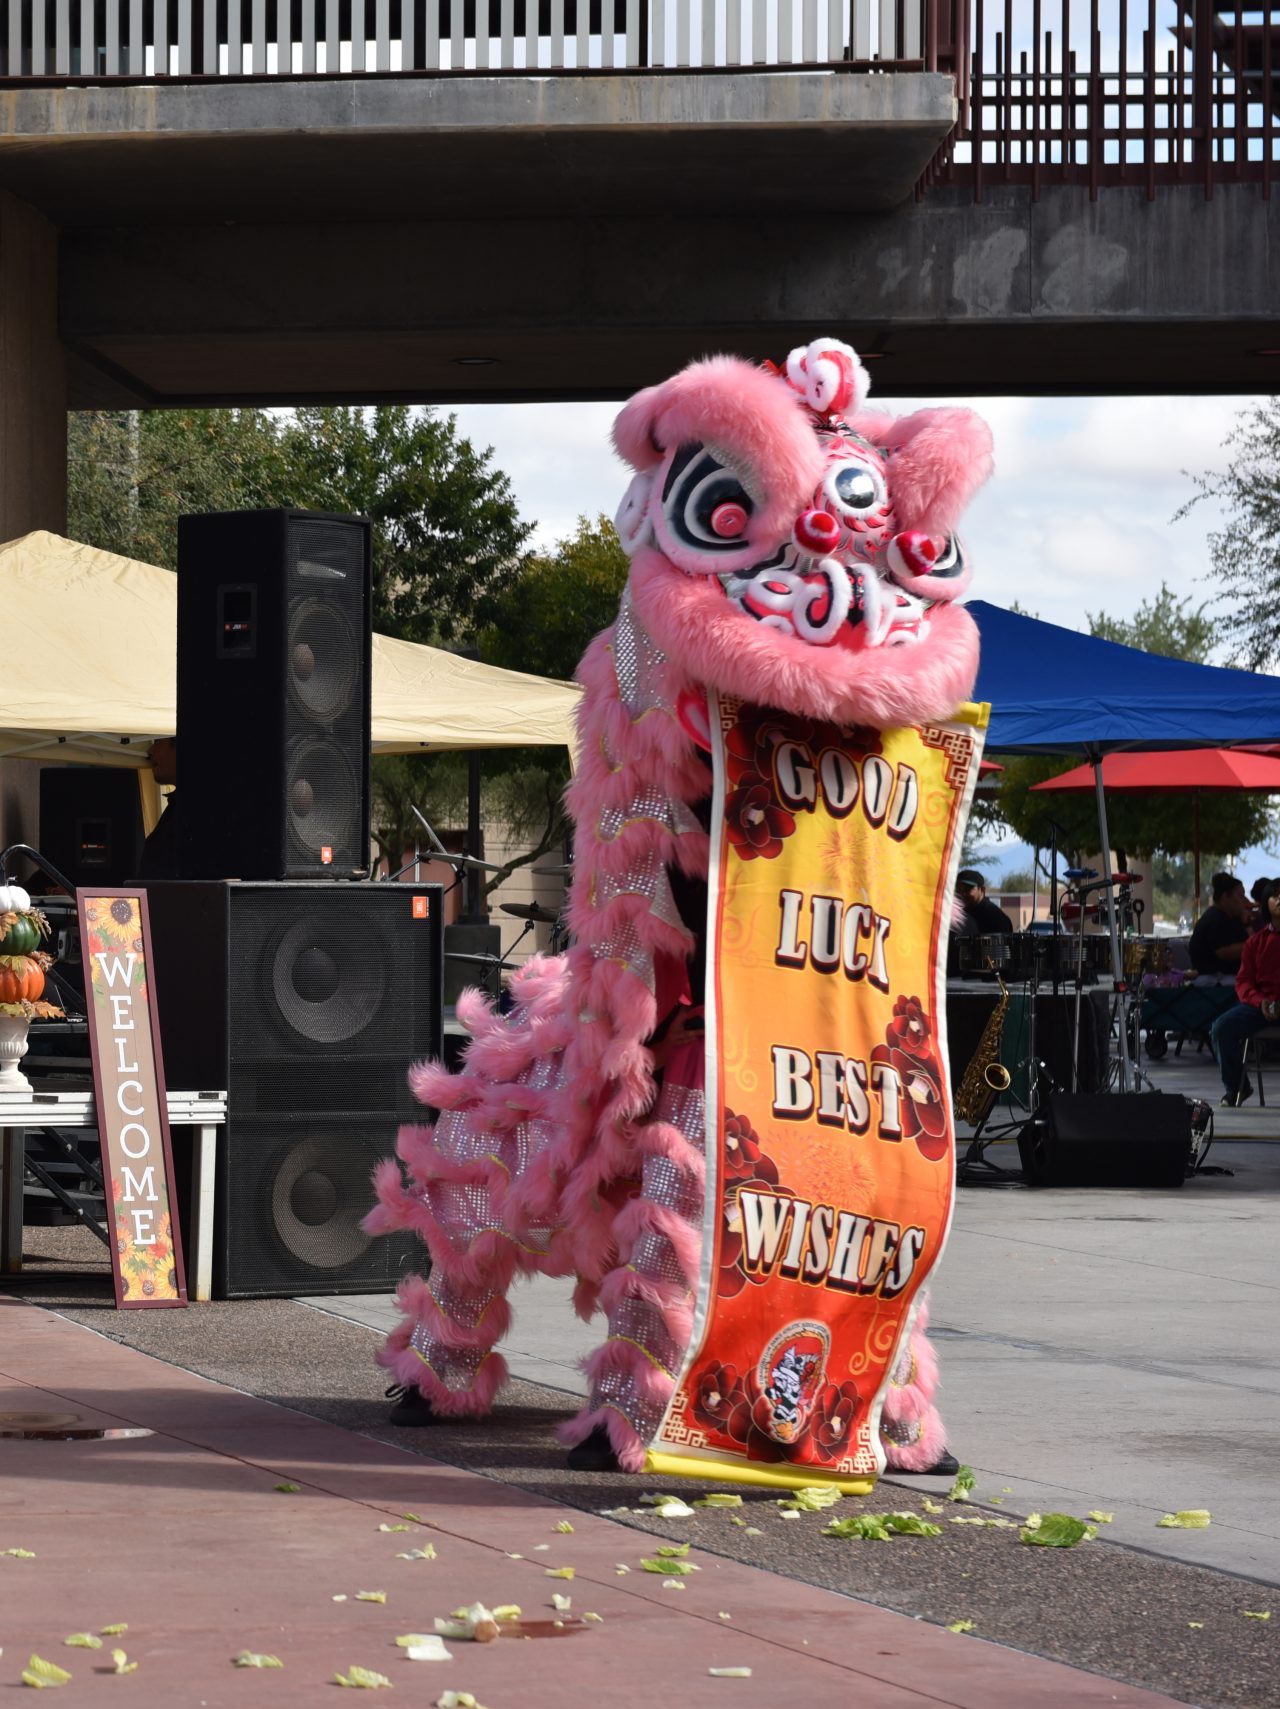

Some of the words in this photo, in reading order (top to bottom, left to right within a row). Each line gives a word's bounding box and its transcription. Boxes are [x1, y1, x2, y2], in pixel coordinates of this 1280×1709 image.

[774, 740, 918, 842] GOOD
[775, 888, 890, 995] LUCK
[95, 952, 159, 1246] WELCOME
[771, 1045, 903, 1142] BEST
[740, 1189, 926, 1299] WISHES
